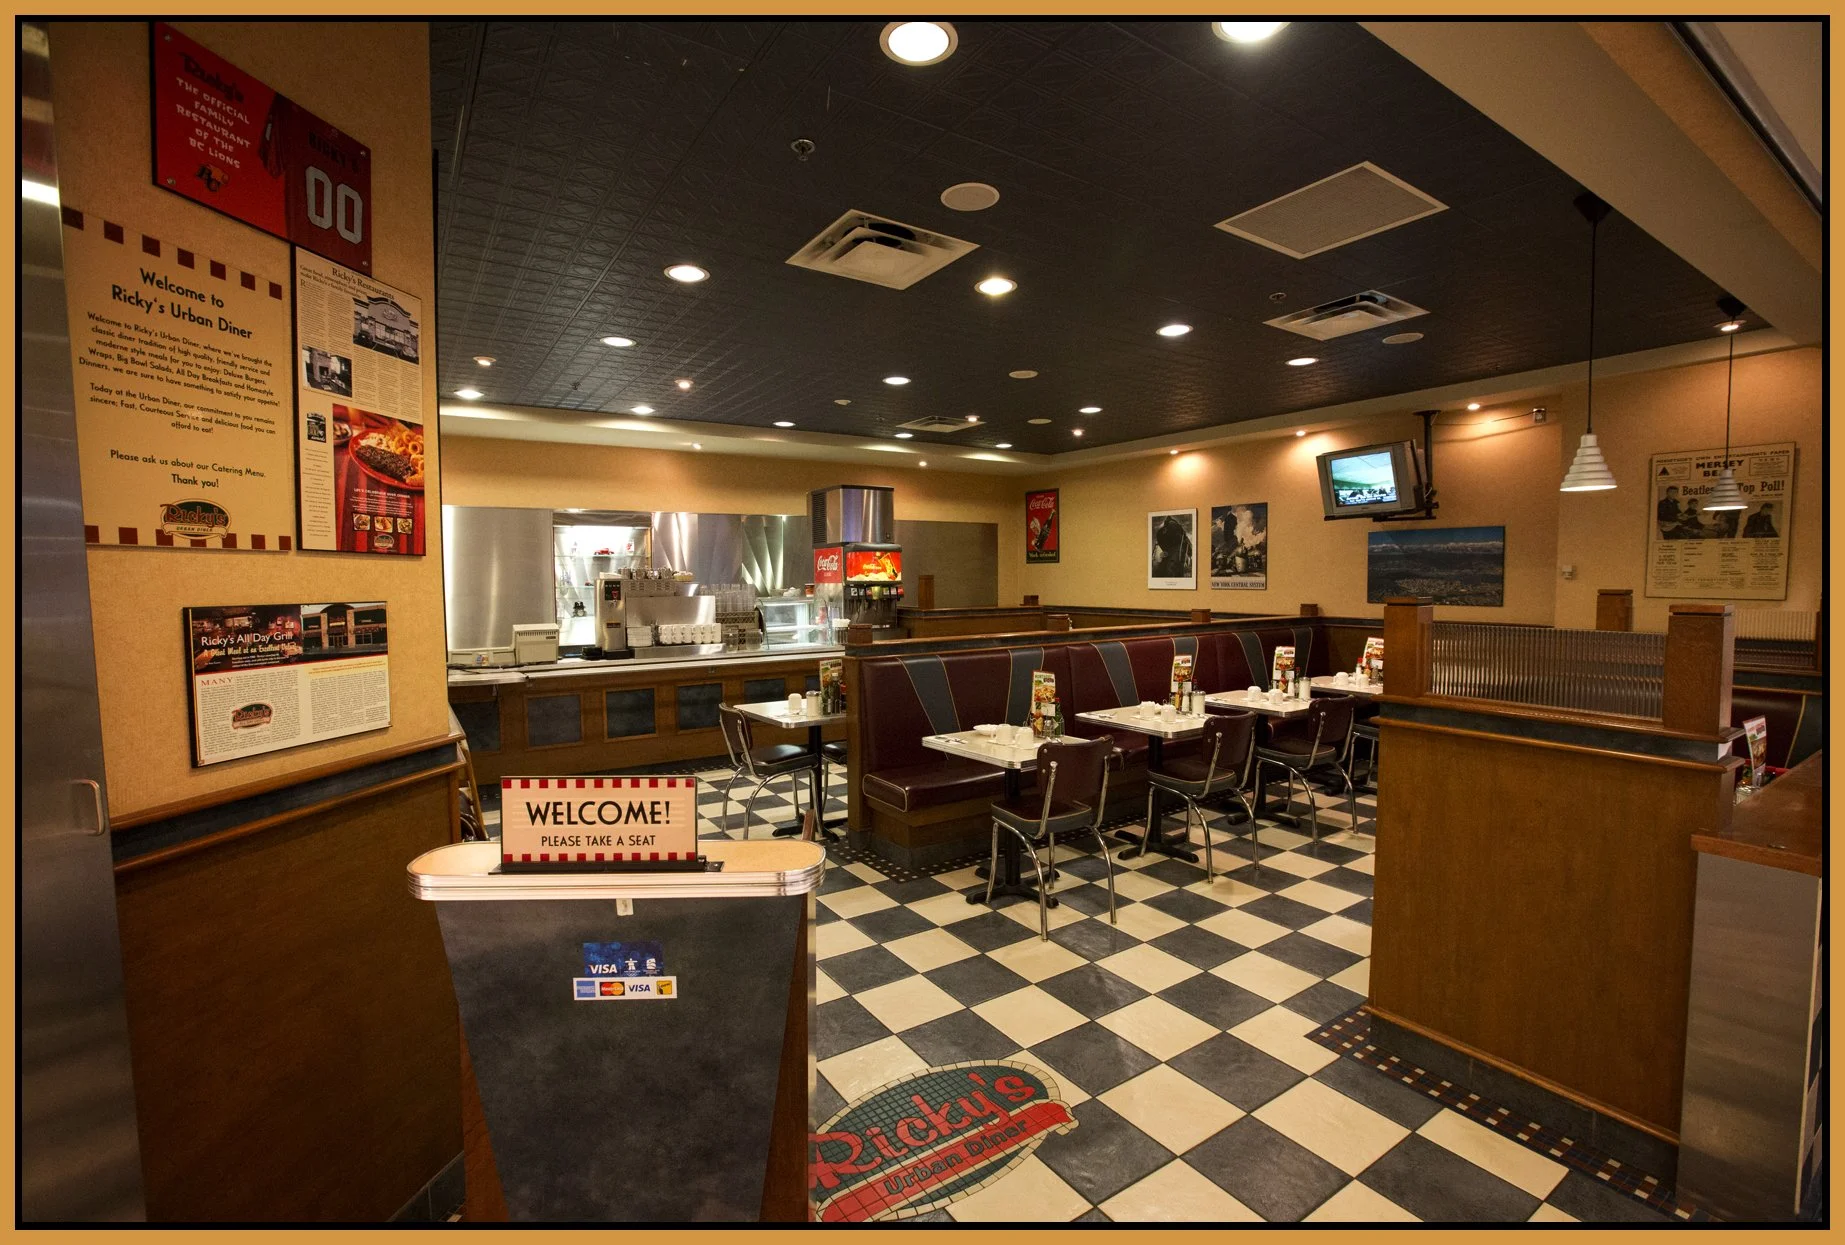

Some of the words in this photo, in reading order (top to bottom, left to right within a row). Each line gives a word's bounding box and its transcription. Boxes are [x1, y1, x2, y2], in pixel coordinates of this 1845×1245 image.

[176, 75, 199, 98] THE
[176, 103, 251, 151] RESTAURANT
[188, 136, 204, 152] BC
[195, 127, 210, 142] OF
[213, 136, 234, 154] THE
[305, 165, 363, 245] 00
[140, 268, 206, 303] Welcome
[211, 294, 224, 309] to
[332, 268, 356, 286] Ricky's
[358, 279, 394, 300] Restaurants
[111, 284, 165, 318] Ricky's
[171, 302, 212, 328] Urban
[218, 317, 252, 339] Diner
[87, 312, 121, 327] Welcome
[125, 322, 131, 330] to
[134, 324, 157, 338] Ricky's
[160, 331, 180, 343] Urban
[203, 343, 221, 354] where
[223, 349, 240, 359] we've
[242, 353, 262, 365] brought
[264, 359, 272, 367] the
[92, 325, 115, 337] classic
[118, 332, 135, 342] diner
[139, 337, 166, 350] tradition
[169, 344, 176, 354] of
[178, 347, 191, 357] high
[217, 357, 237, 369] friendly
[240, 365, 258, 373] service
[260, 368, 270, 376] and
[117, 354, 128, 365] Big
[130, 357, 148, 368] Bowl
[176, 368, 185, 376] All
[187, 370, 199, 380] Day
[202, 373, 232, 387] Breakfasts
[247, 384, 274, 397] Homestyle
[131, 346, 145, 357] style
[149, 351, 168, 361] meals
[170, 356, 179, 365] for
[182, 361, 193, 369] you
[224, 369, 243, 379] Deluxe
[141, 372, 154, 380] sure
[166, 376, 181, 385] have
[184, 380, 214, 394] something
[224, 389, 241, 400] satisfy
[90, 383, 113, 395] Today
[116, 388, 123, 396] at
[126, 389, 136, 398] the
[139, 392, 160, 403] Urban
[197, 405, 233, 417] commitment
[254, 416, 274, 425] remains
[140, 403, 173, 416] Courteous
[215, 418, 238, 428] delicious
[241, 423, 253, 431] food
[171, 421, 191, 430] afford
[110, 450, 139, 462] Please
[142, 454, 156, 464] ask
[171, 458, 193, 469] about
[196, 463, 209, 471] our
[212, 463, 242, 476] Catering
[1696, 459, 1744, 469] MERSEY
[171, 474, 198, 486] Thank
[201, 477, 219, 489] you!
[1737, 482, 1755, 494] Top
[1760, 480, 1784, 491] Poll!
[160, 503, 227, 528] Ricky's
[817, 555, 839, 571] Coca-Cola
[201, 635, 234, 650] Ricky's
[237, 634, 249, 644] All
[253, 633, 271, 645] Day
[273, 630, 293, 641] Grill
[201, 677, 233, 686] MANY
[525, 801, 670, 826] WELCOME!
[541, 835, 581, 847] PLEASE
[585, 835, 612, 846] TAKE
[616, 835, 625, 846] A
[628, 834, 656, 846] SEAT
[589, 963, 618, 974] VISA
[628, 984, 651, 992] VISA
[808, 1072, 1036, 1190] Ricky's
[883, 1152, 962, 1196] Urban
[964, 1118, 1027, 1156] Diner
